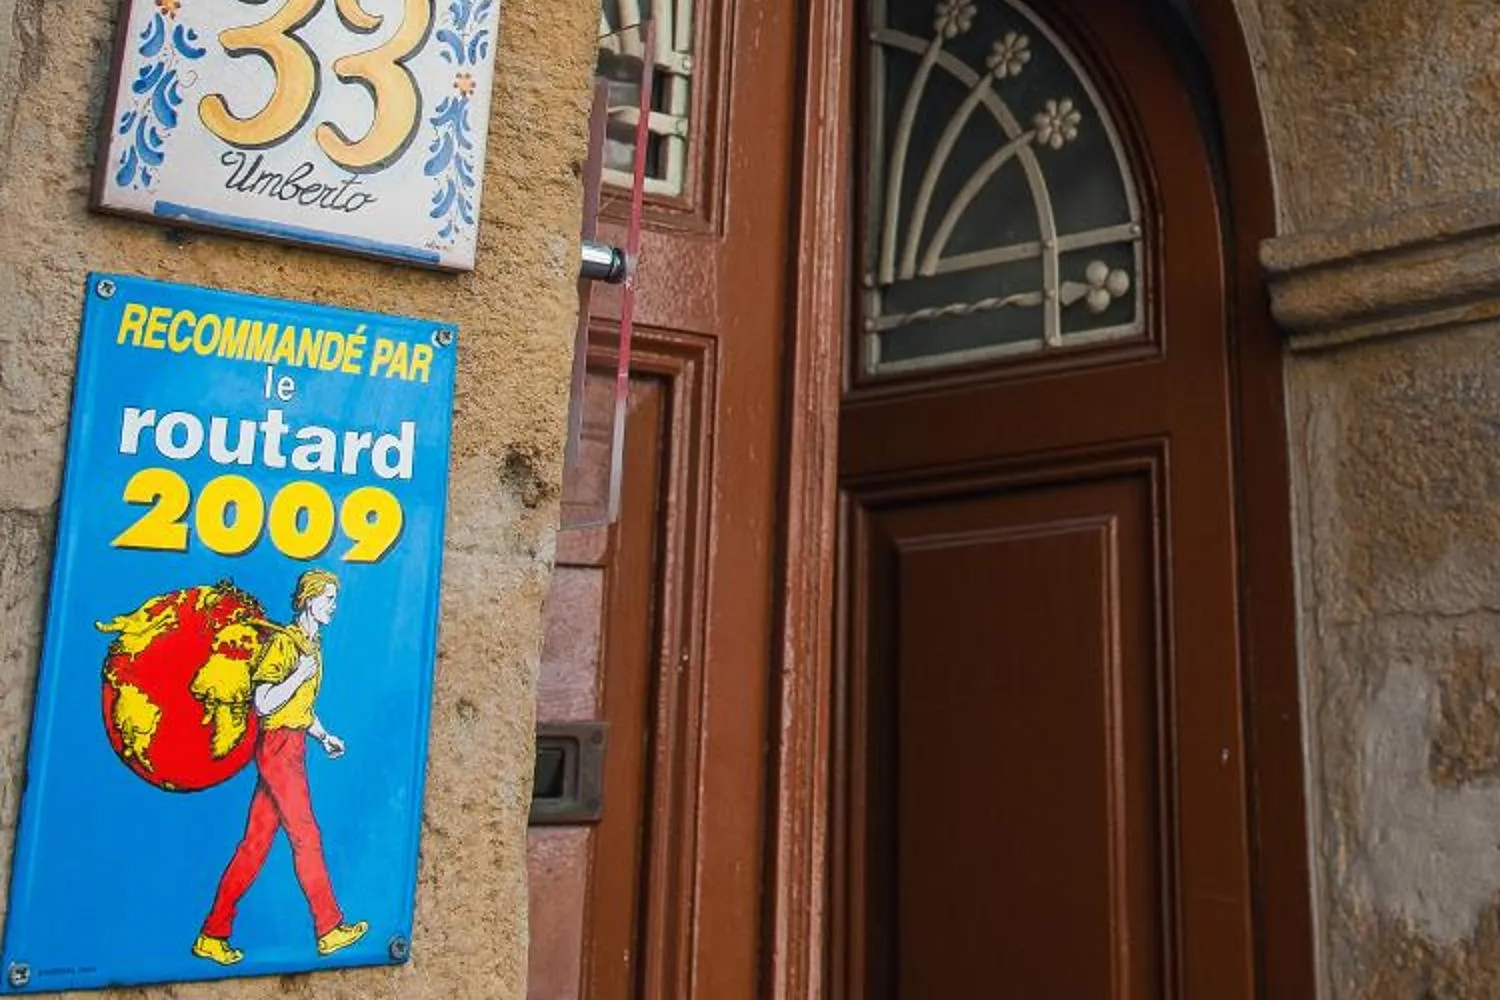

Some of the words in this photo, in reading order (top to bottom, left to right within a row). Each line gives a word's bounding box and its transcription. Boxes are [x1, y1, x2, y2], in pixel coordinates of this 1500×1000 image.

[221, 151, 376, 212] Umberto
[115, 302, 365, 376] RECOMMANDÉ
[371, 336, 433, 383] PAR
[264, 365, 295, 401] le
[118, 405, 415, 480] routard
[110, 468, 405, 564] 2009
